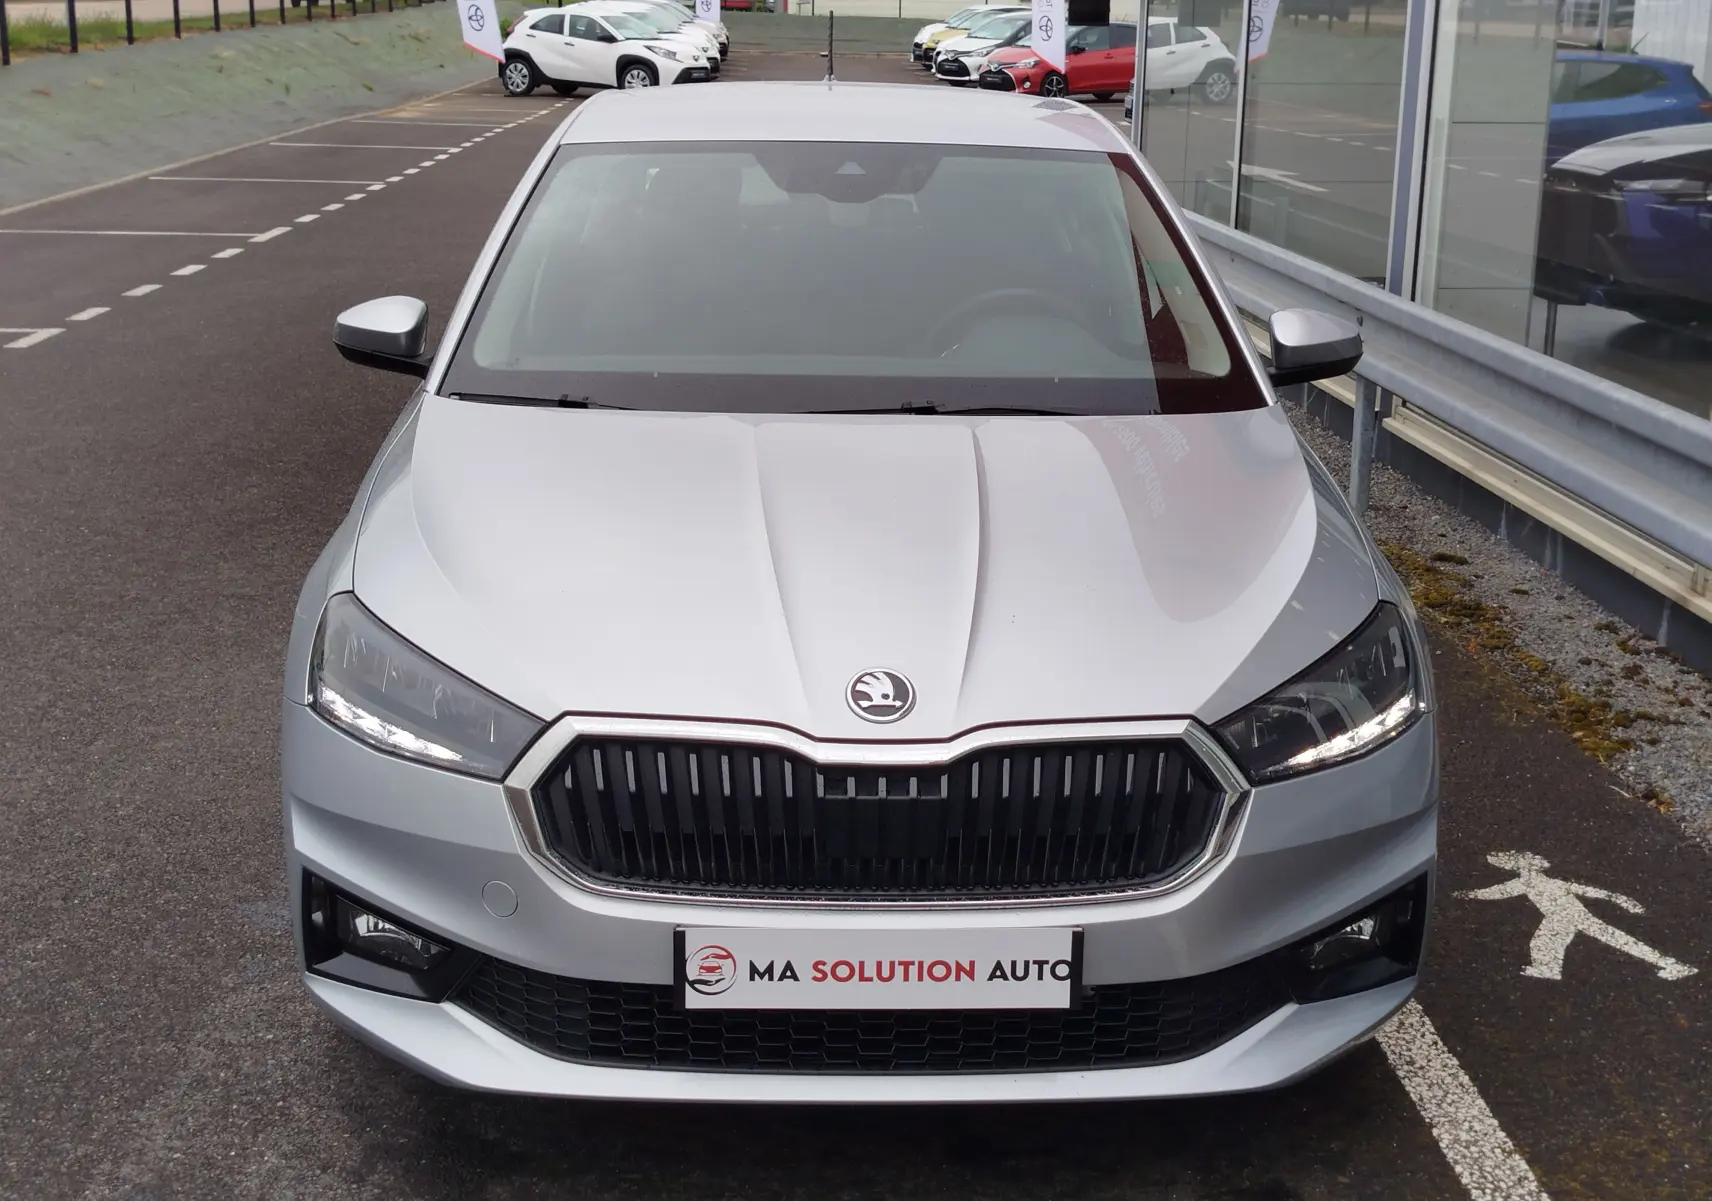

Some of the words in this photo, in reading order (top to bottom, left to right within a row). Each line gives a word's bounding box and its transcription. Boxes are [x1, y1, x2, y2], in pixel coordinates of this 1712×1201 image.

[749, 960, 800, 982] MA
[811, 959, 976, 982] SOLUTION
[987, 959, 1072, 982] AUTO
